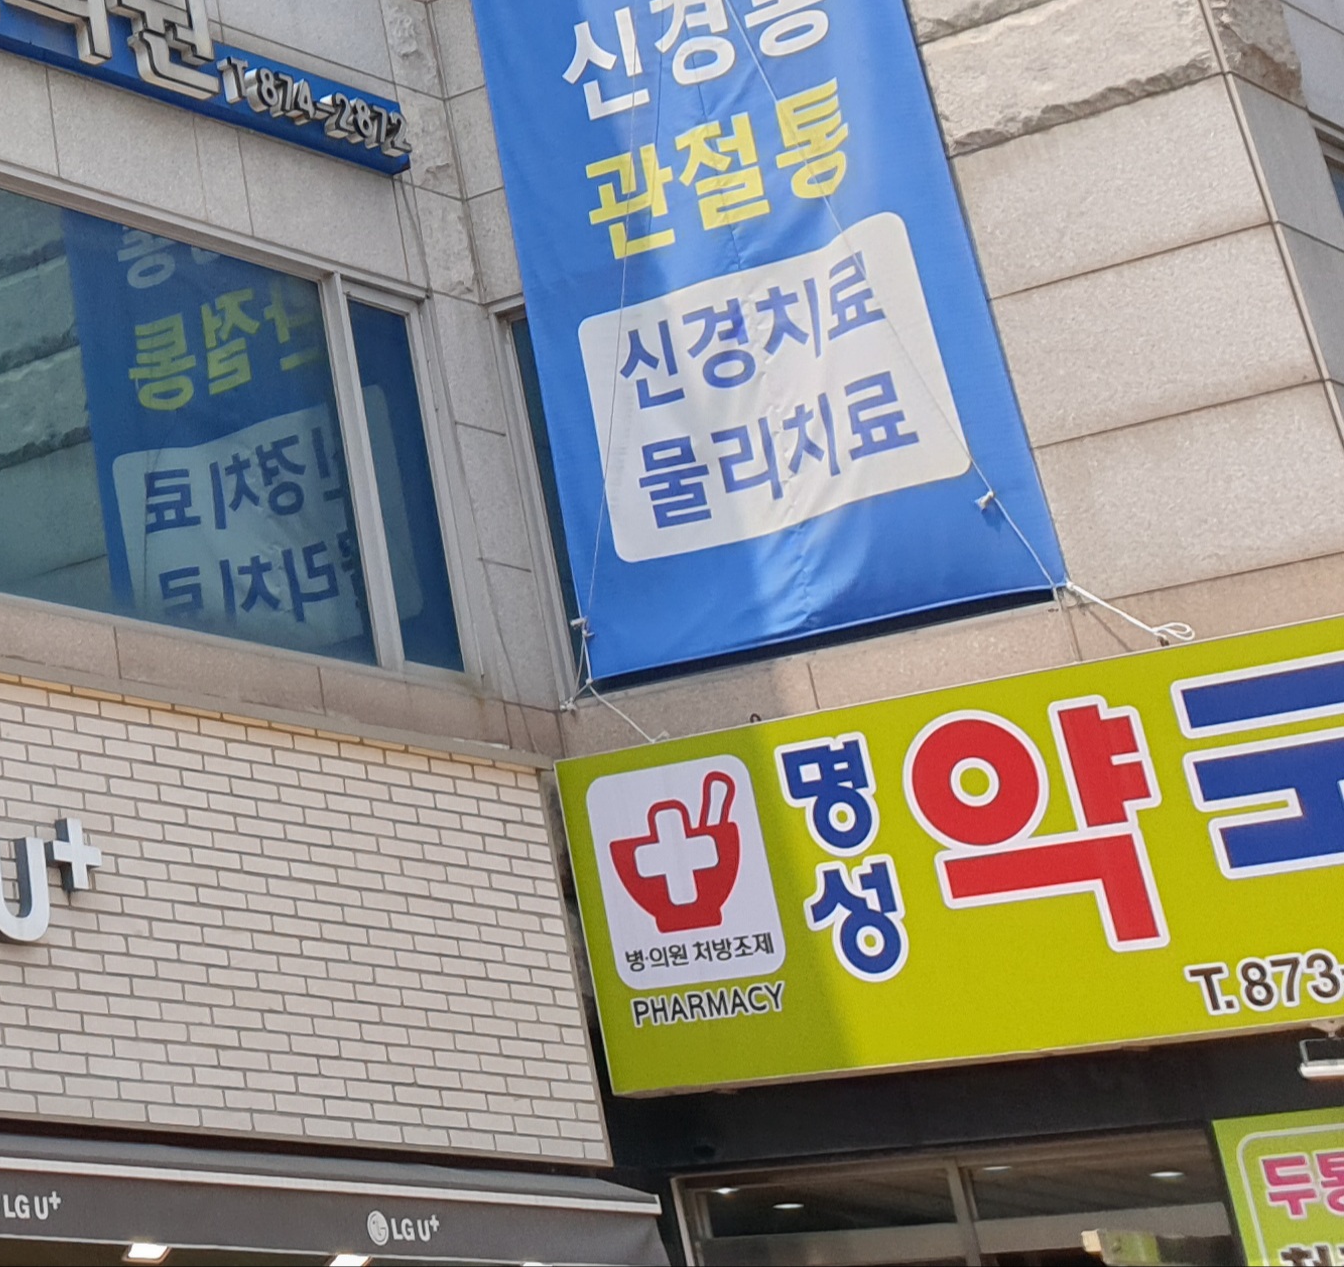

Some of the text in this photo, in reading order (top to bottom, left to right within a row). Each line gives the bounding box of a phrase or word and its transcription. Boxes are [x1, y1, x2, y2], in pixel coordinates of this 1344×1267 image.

[585, 78, 851, 259] 관절통
[619, 251, 887, 409] 신경치료
[638, 370, 919, 530] 물리치료
[631, 981, 784, 1027] PHARMACY
[693, 931, 775, 963] 처방조제
